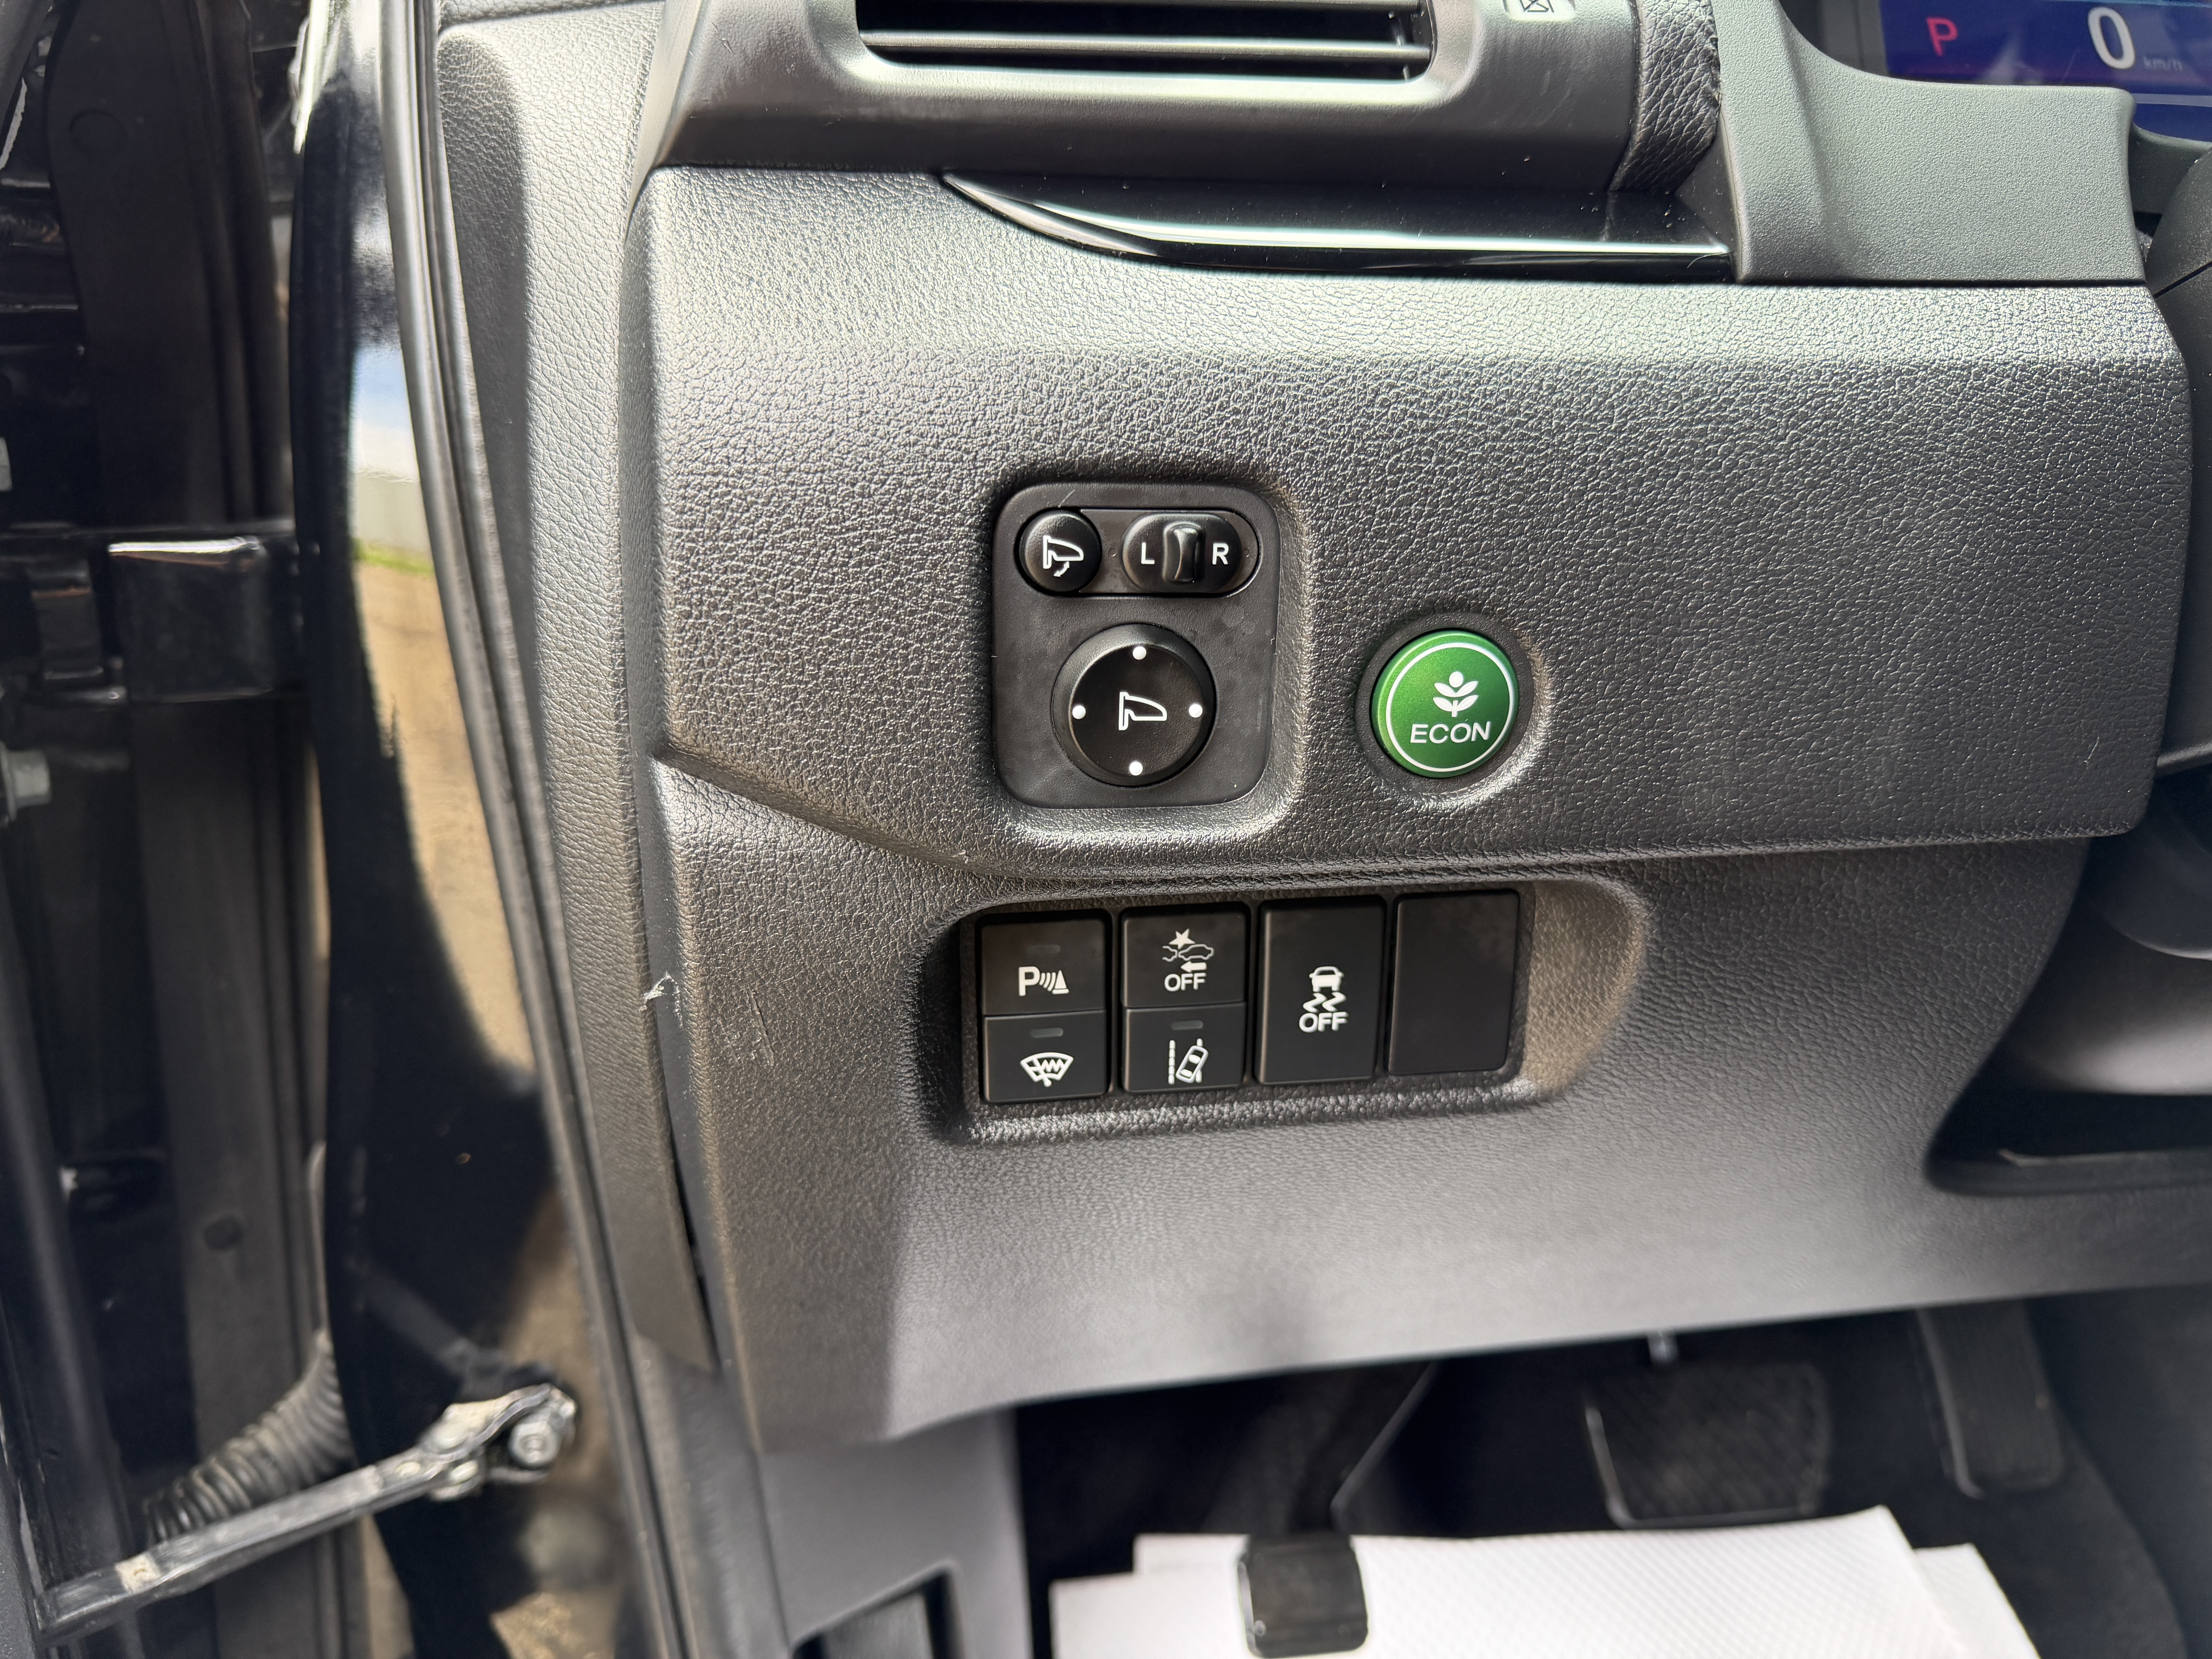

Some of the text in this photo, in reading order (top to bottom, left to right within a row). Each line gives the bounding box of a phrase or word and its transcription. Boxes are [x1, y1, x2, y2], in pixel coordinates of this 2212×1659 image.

[1926, 17, 1958, 56] P
[2087, 7, 2135, 69] 0
[1141, 543, 1229, 565] L R
[1410, 721, 1491, 744] ECON
[1019, 966, 1039, 996] P
[1164, 972, 1206, 991] OFF
[1299, 1012, 1348, 1033] OFF
